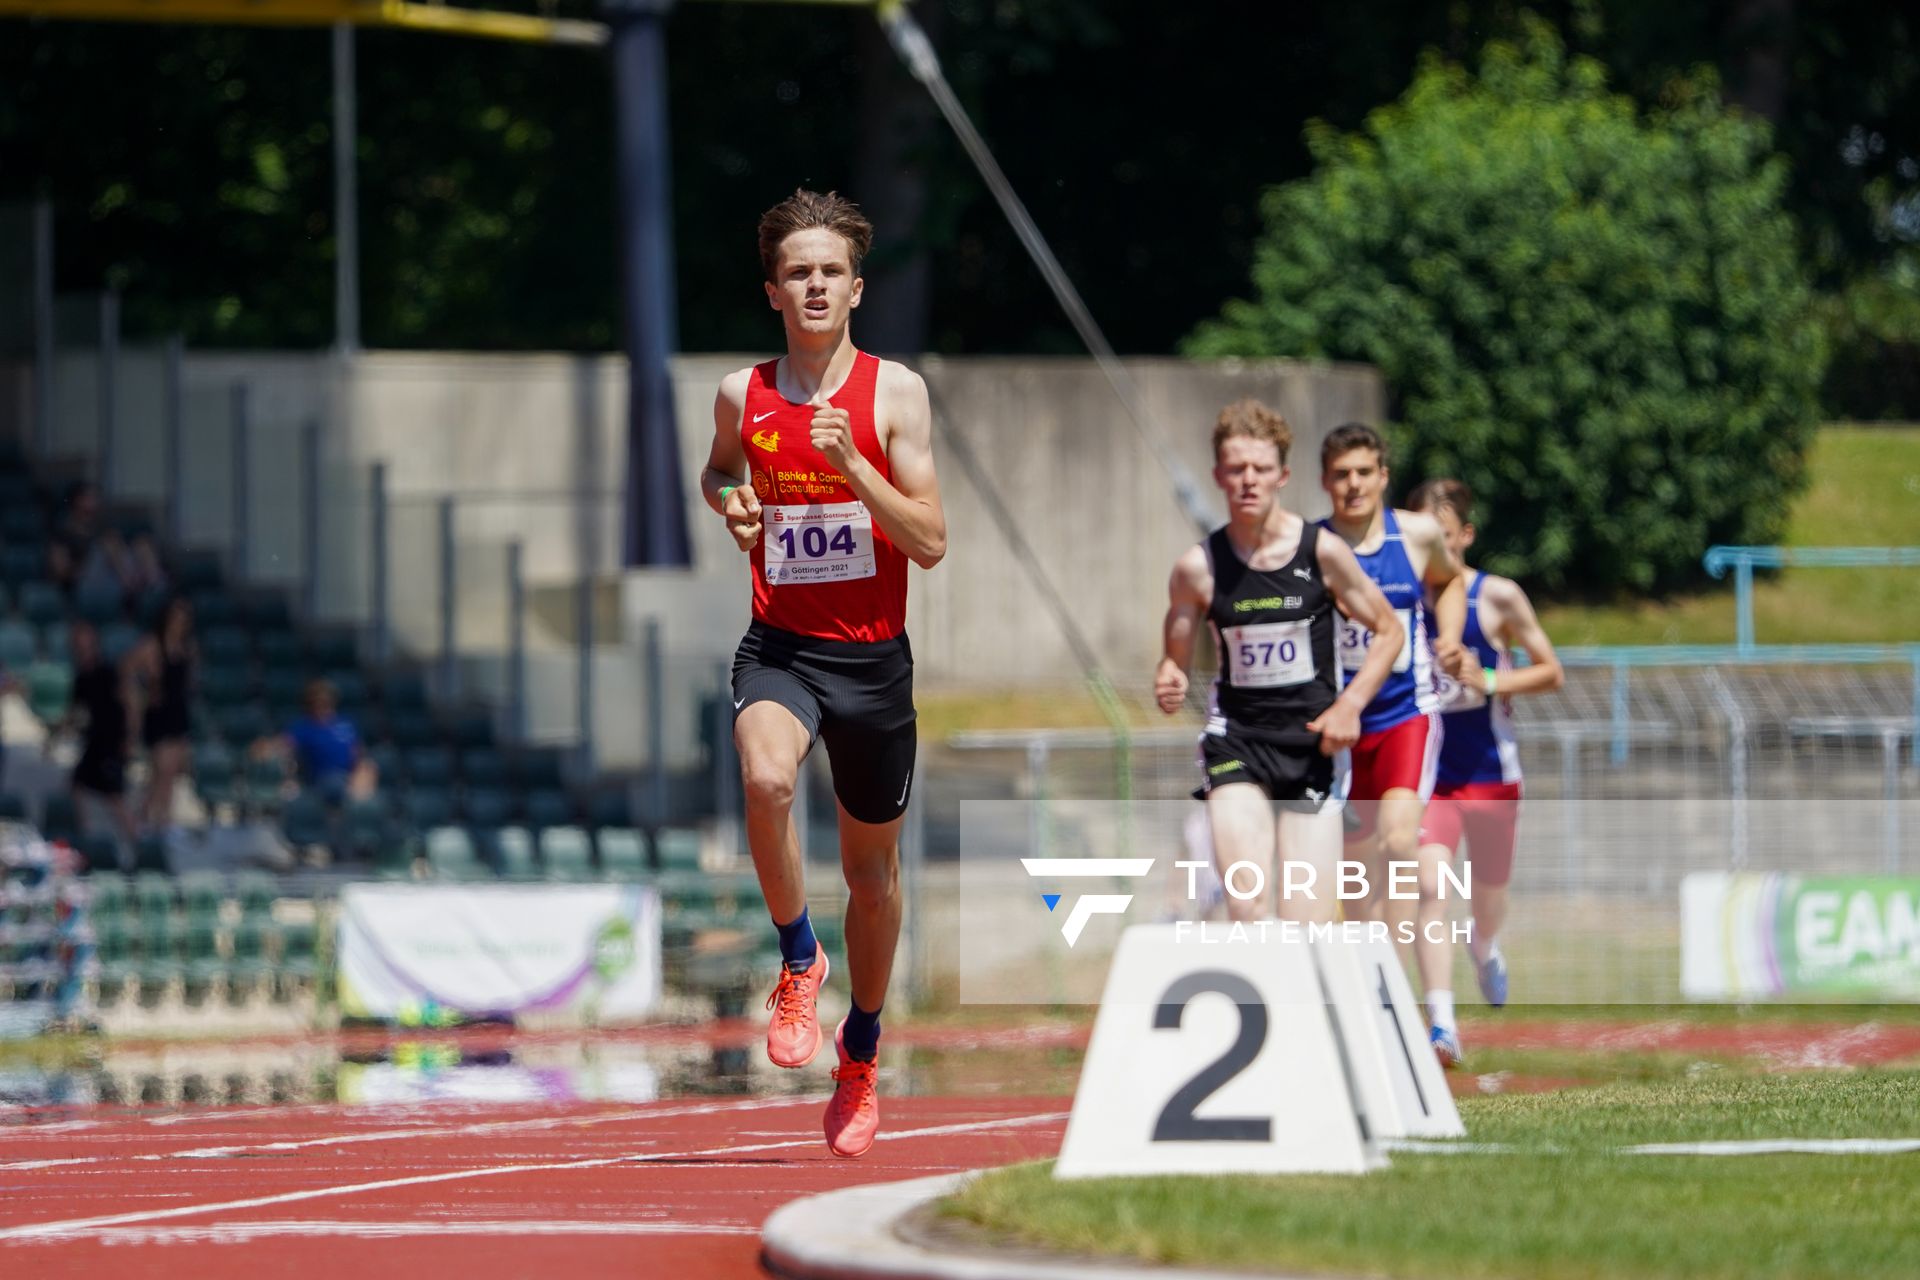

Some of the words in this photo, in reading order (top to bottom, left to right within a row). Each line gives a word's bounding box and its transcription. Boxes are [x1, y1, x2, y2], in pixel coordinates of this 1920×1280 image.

[777, 471, 807, 482] Böhke
[809, 472, 817, 482] &
[780, 482, 834, 494] Consultants
[823, 511, 857, 519] Göttingen
[778, 524, 857, 559] 104
[791, 566, 829, 576] Göttingen
[831, 563, 849, 572] 2021
[1240, 640, 1296, 667] 570
[1377, 962, 1429, 1118] 1
[1150, 968, 1273, 1143] 2
